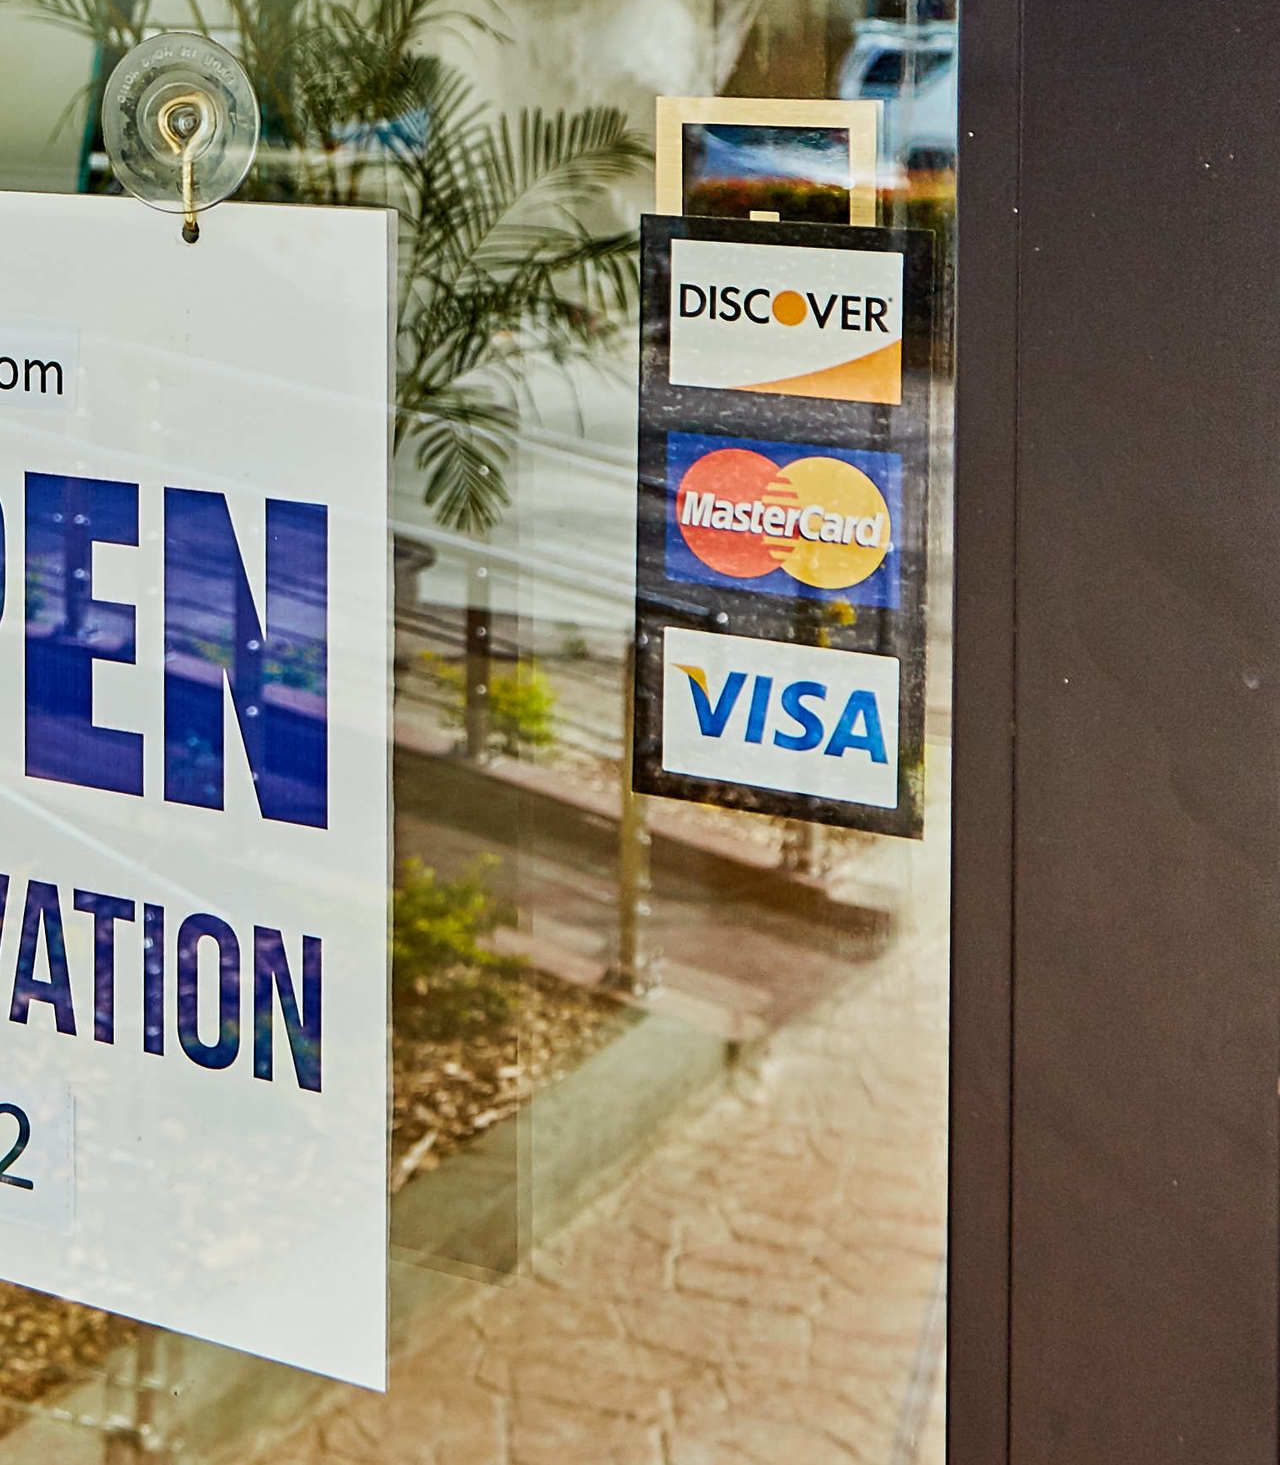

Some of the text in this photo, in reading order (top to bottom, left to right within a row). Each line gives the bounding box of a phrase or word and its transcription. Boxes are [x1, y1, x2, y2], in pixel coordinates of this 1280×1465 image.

[679, 282, 889, 334] DISCOVER
[680, 490, 887, 550] MasterCard
[672, 662, 889, 765] VISA
